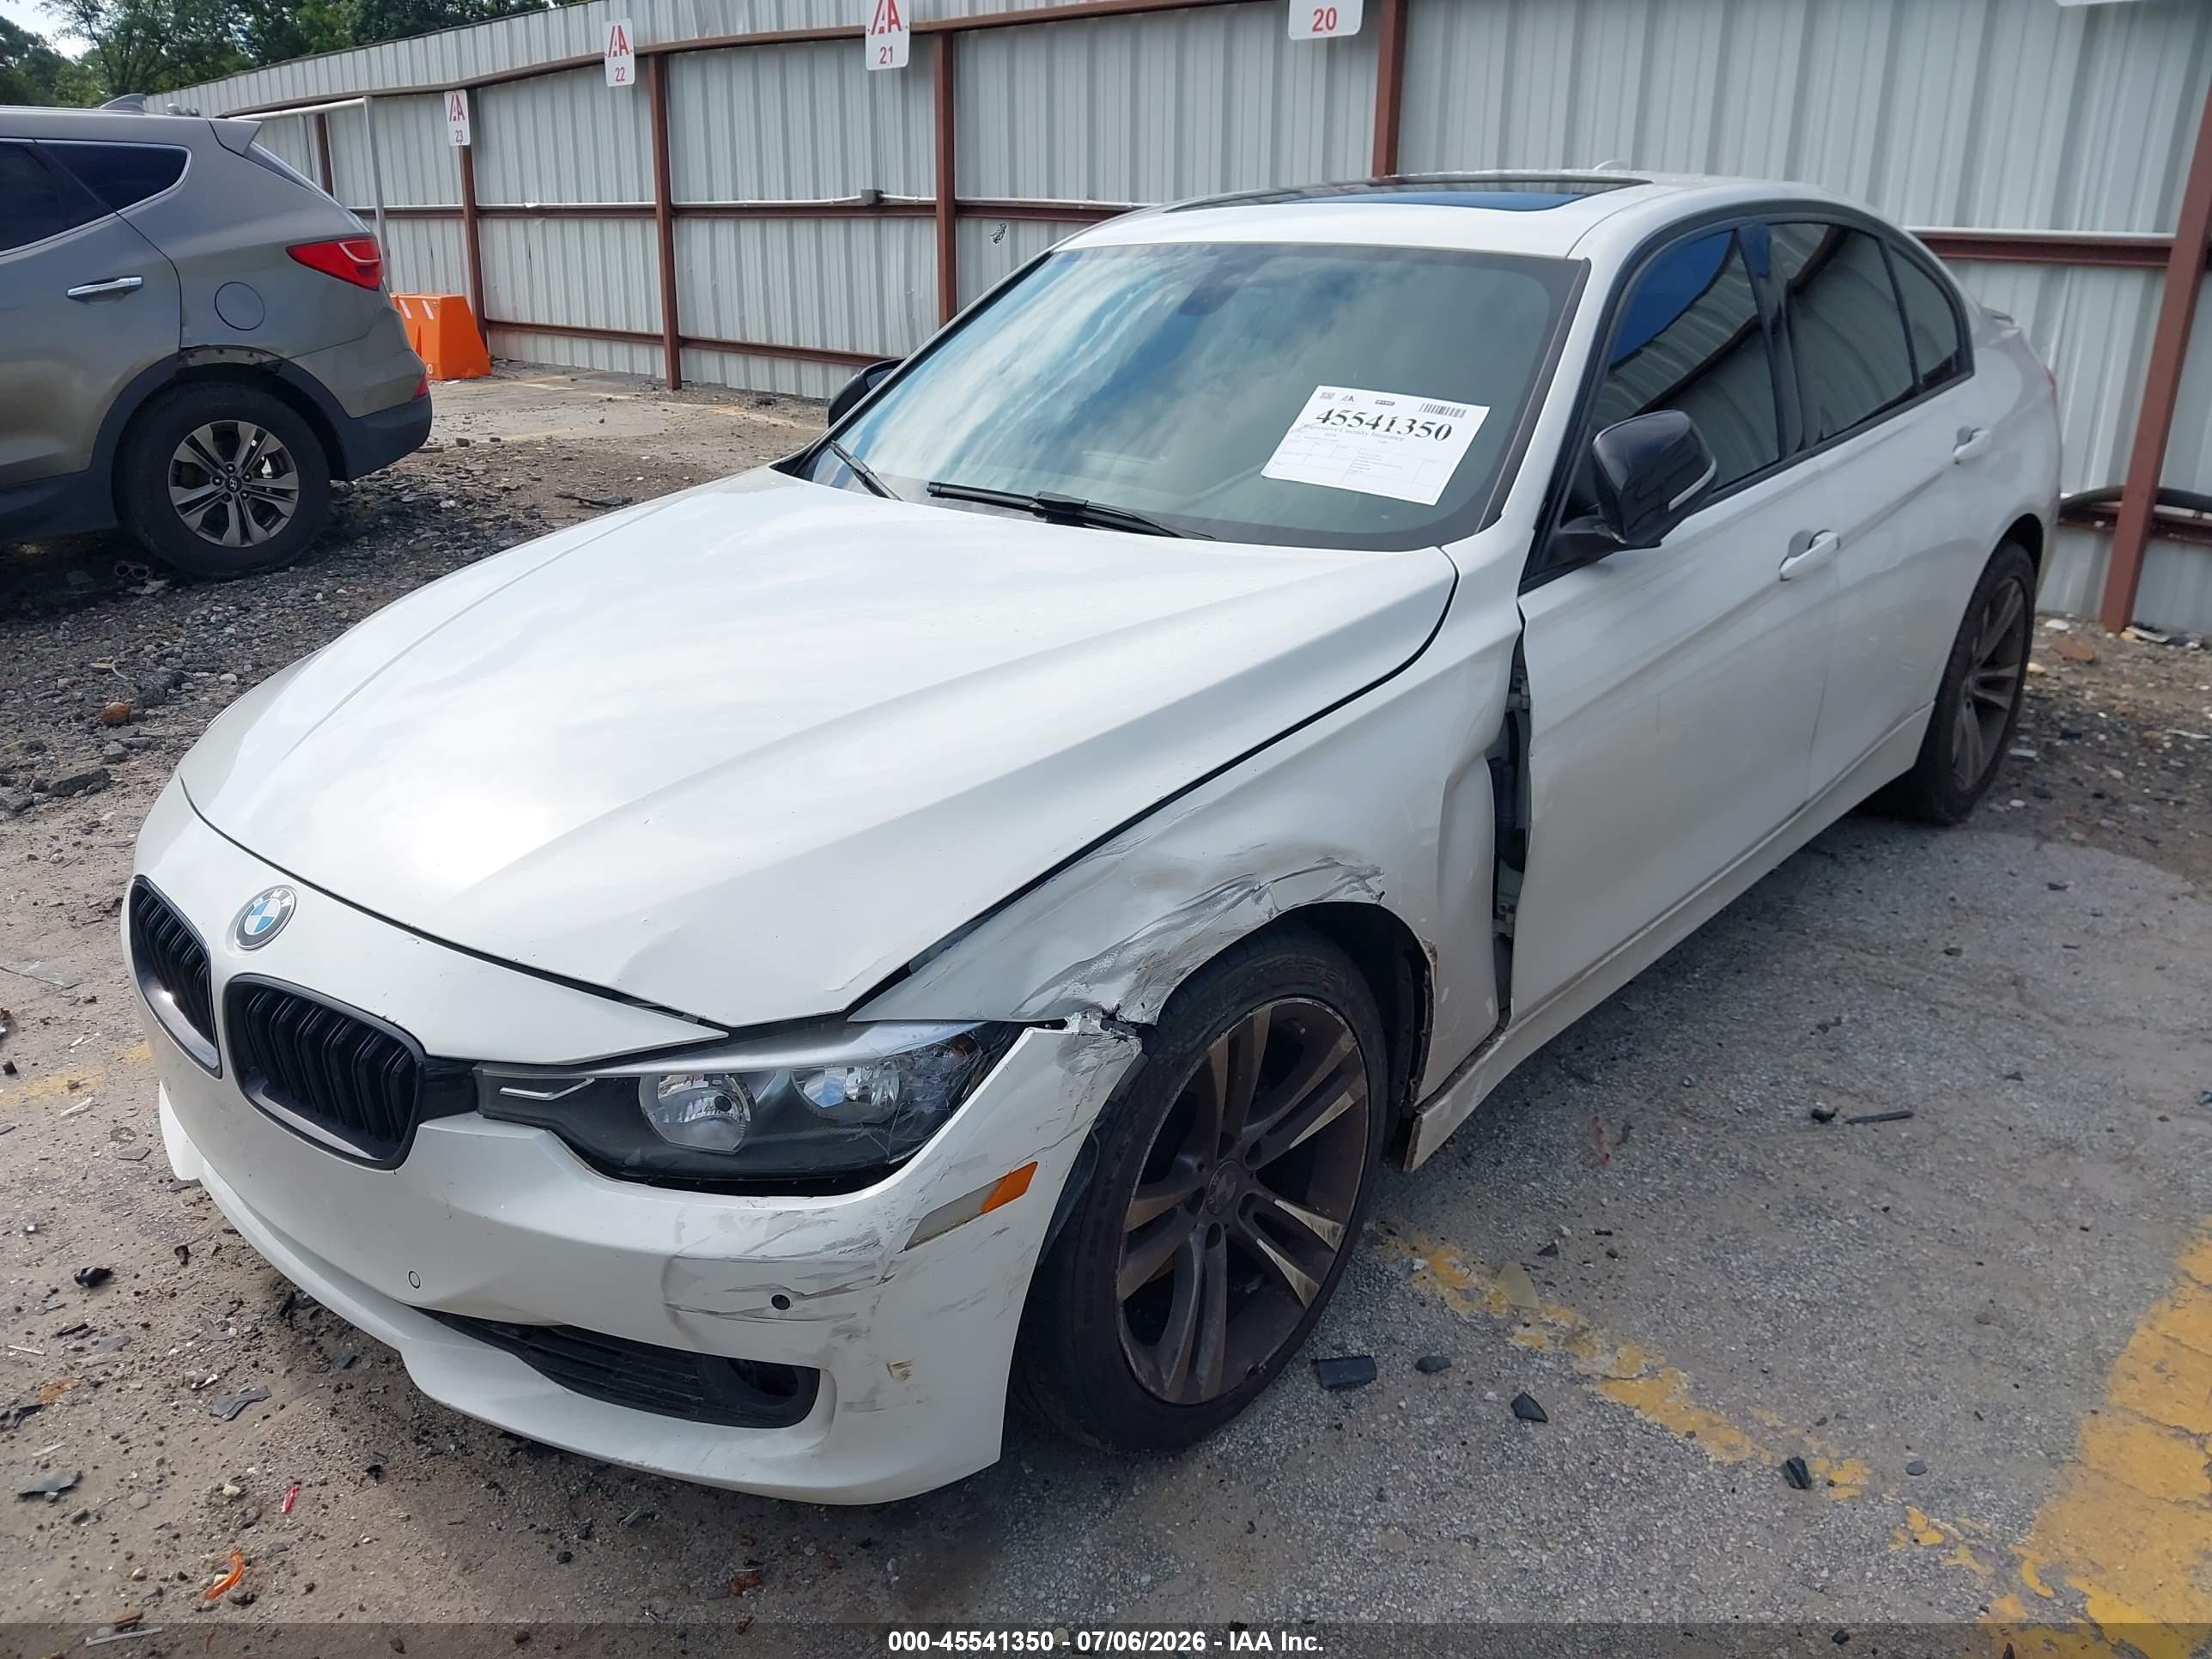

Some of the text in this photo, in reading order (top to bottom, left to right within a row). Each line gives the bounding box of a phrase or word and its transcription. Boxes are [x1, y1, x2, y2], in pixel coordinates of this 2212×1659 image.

[1312, 7, 1337, 32] 20
[879, 46, 894, 64] 21
[615, 66, 626, 82] 22
[455, 130, 464, 143] 23
[1316, 408, 1452, 441] 45541350
